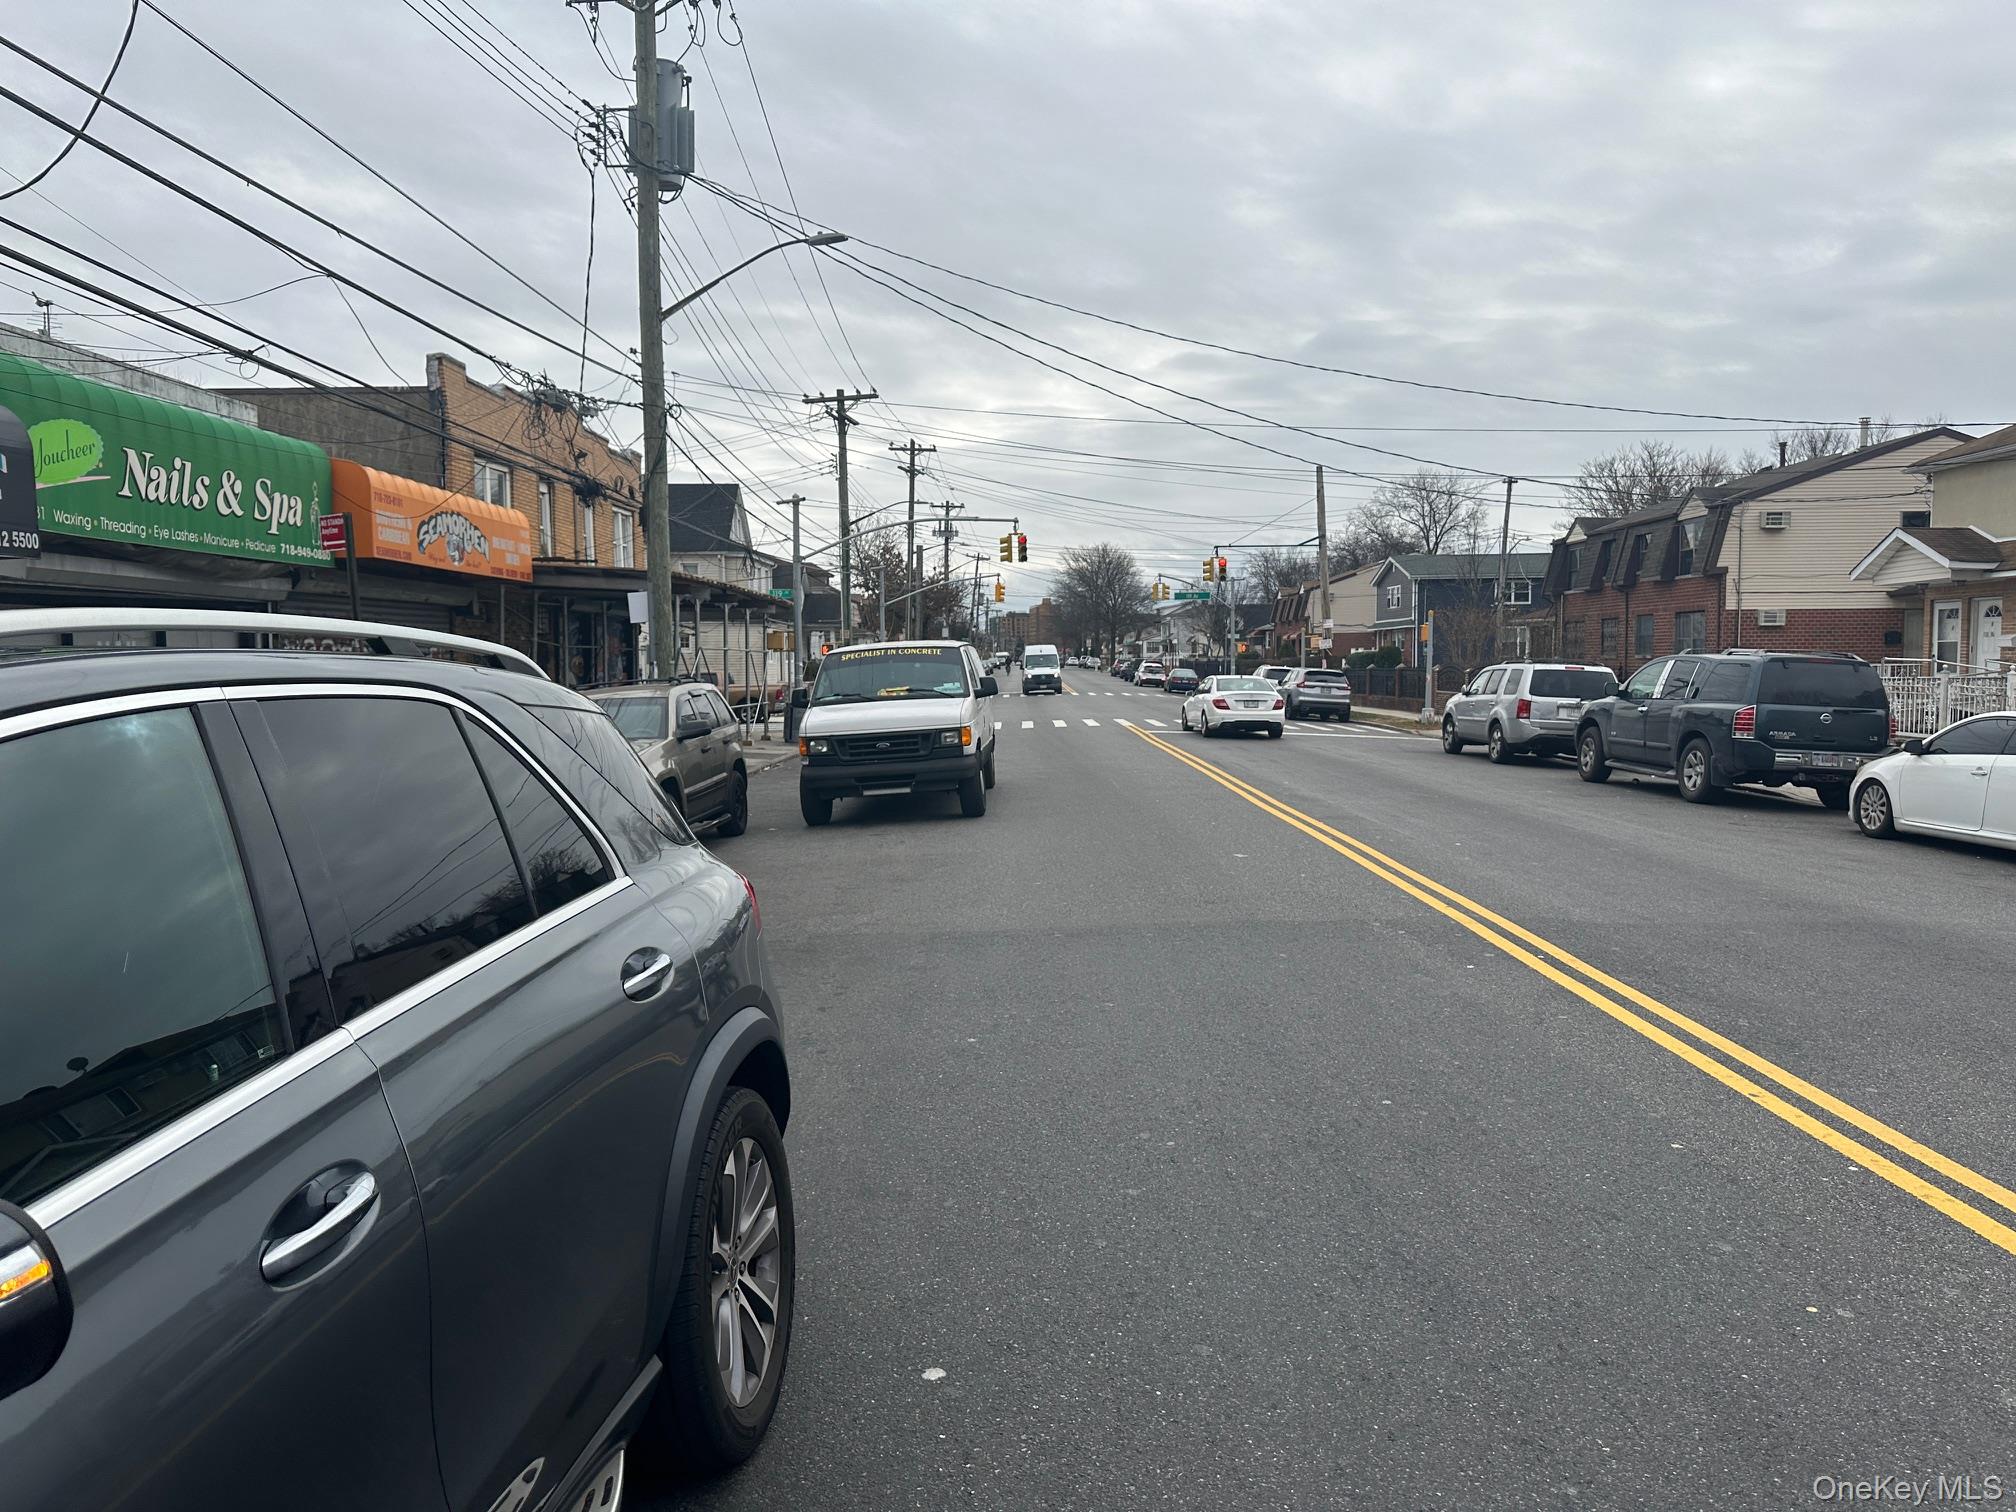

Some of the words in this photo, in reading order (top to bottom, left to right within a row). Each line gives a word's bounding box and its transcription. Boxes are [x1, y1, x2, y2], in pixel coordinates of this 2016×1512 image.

[117, 446, 210, 511] Nails
[216, 469, 244, 518] &
[253, 477, 304, 535] Spa
[0, 530, 10, 547] 2
[12, 530, 39, 549] 5500
[53, 508, 92, 531] Waxing
[99, 516, 146, 539] Threading
[153, 525, 170, 541] Eye
[171, 527, 199, 543] Lashes
[203, 532, 240, 548] Manicure
[245, 538, 277, 554] Pedicure
[841, 649, 885, 661] SPECIALIST
[898, 648, 942, 656] CONCRETE
